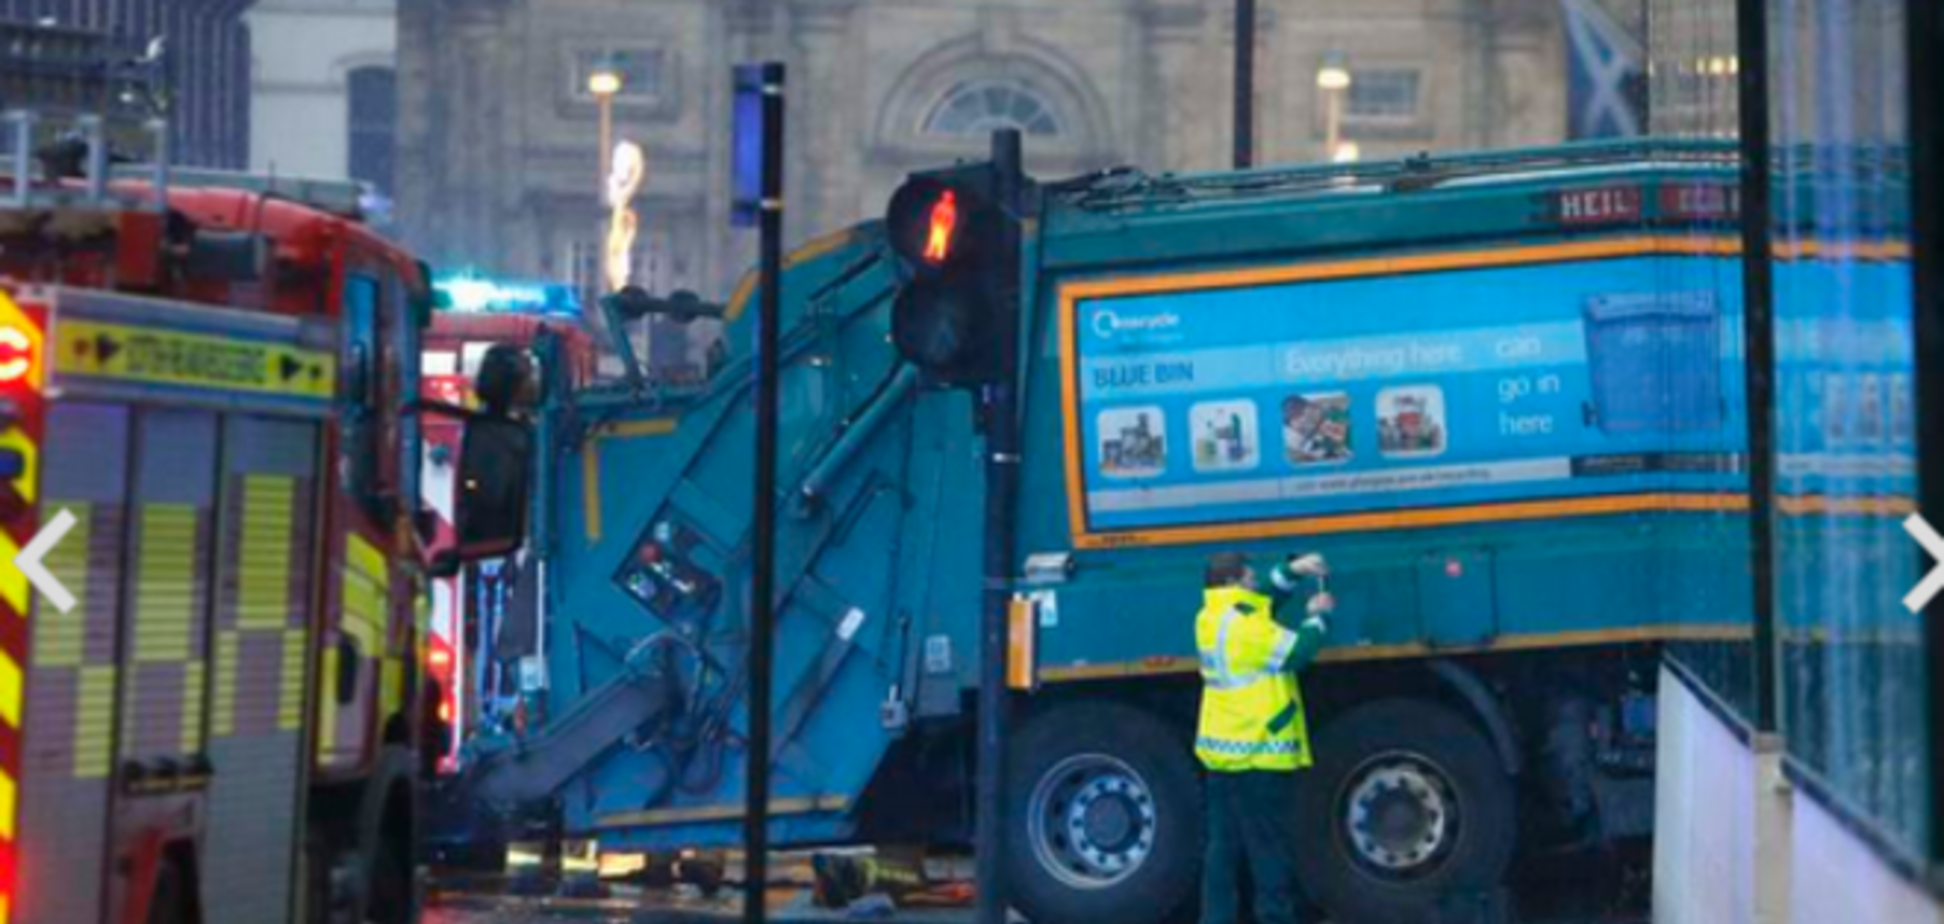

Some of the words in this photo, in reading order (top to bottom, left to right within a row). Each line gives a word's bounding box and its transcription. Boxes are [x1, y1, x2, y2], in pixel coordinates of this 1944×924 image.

[1561, 189, 1632, 217] HEIL
[1285, 341, 1405, 377] Everything
[1412, 339, 1462, 367] here
[1495, 336, 1542, 358] can
[1094, 364, 1151, 388] BLUE
[1155, 360, 1194, 384] BIN
[1498, 377, 1531, 403] go
[1536, 367, 1560, 393] in
[1500, 409, 1554, 436] here
